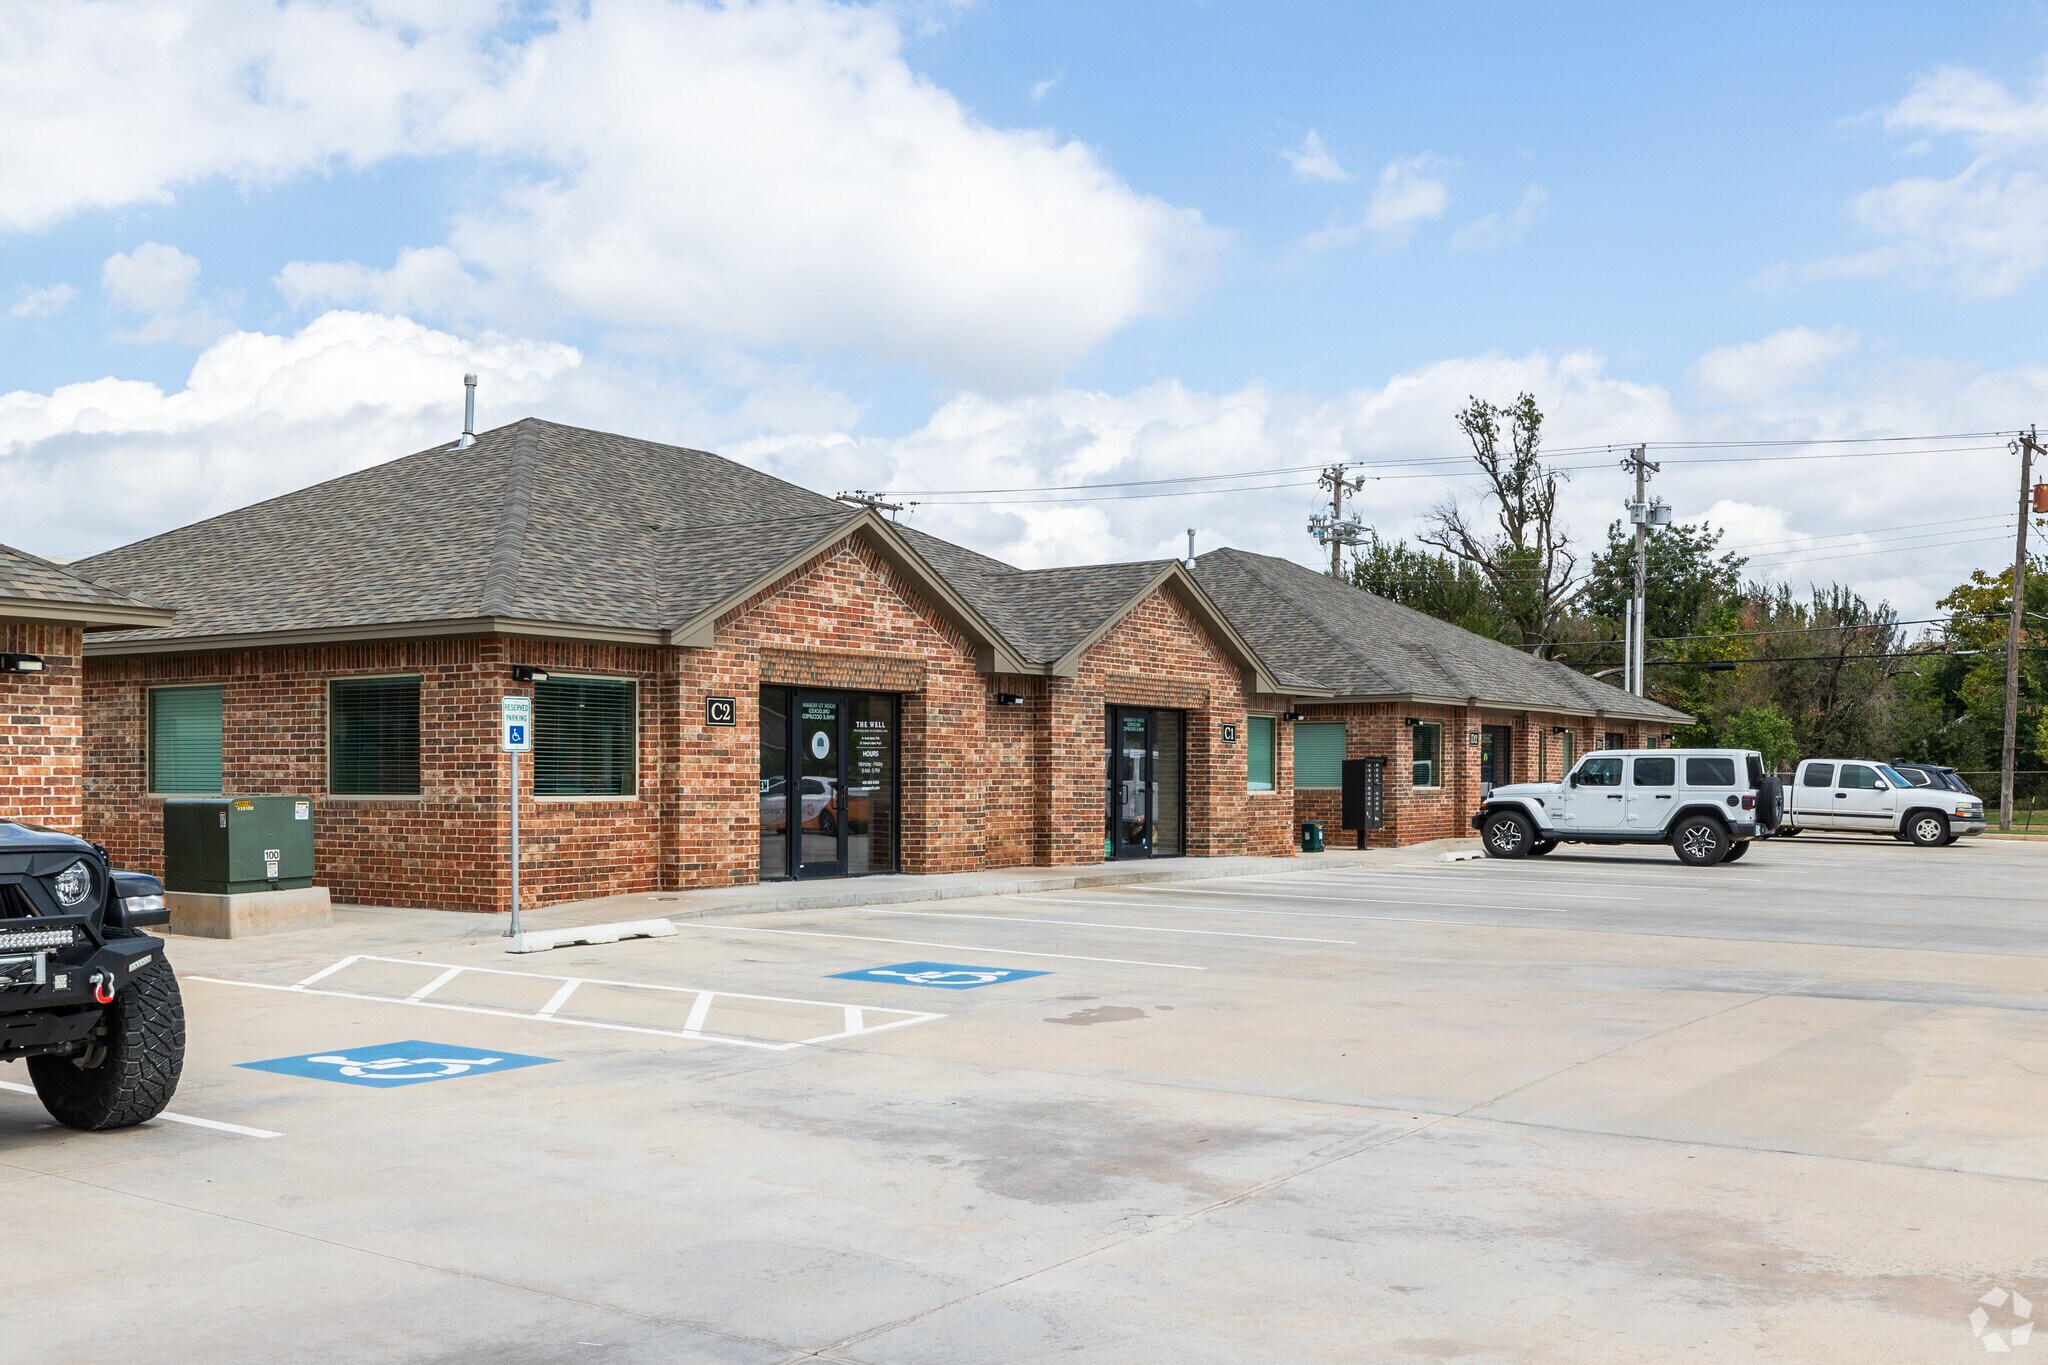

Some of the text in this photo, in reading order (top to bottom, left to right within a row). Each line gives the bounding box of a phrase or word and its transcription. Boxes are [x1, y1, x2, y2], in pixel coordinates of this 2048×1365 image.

[711, 702, 731, 720] C2
[1225, 727, 1234, 740] C1
[266, 851, 279, 859] 100
